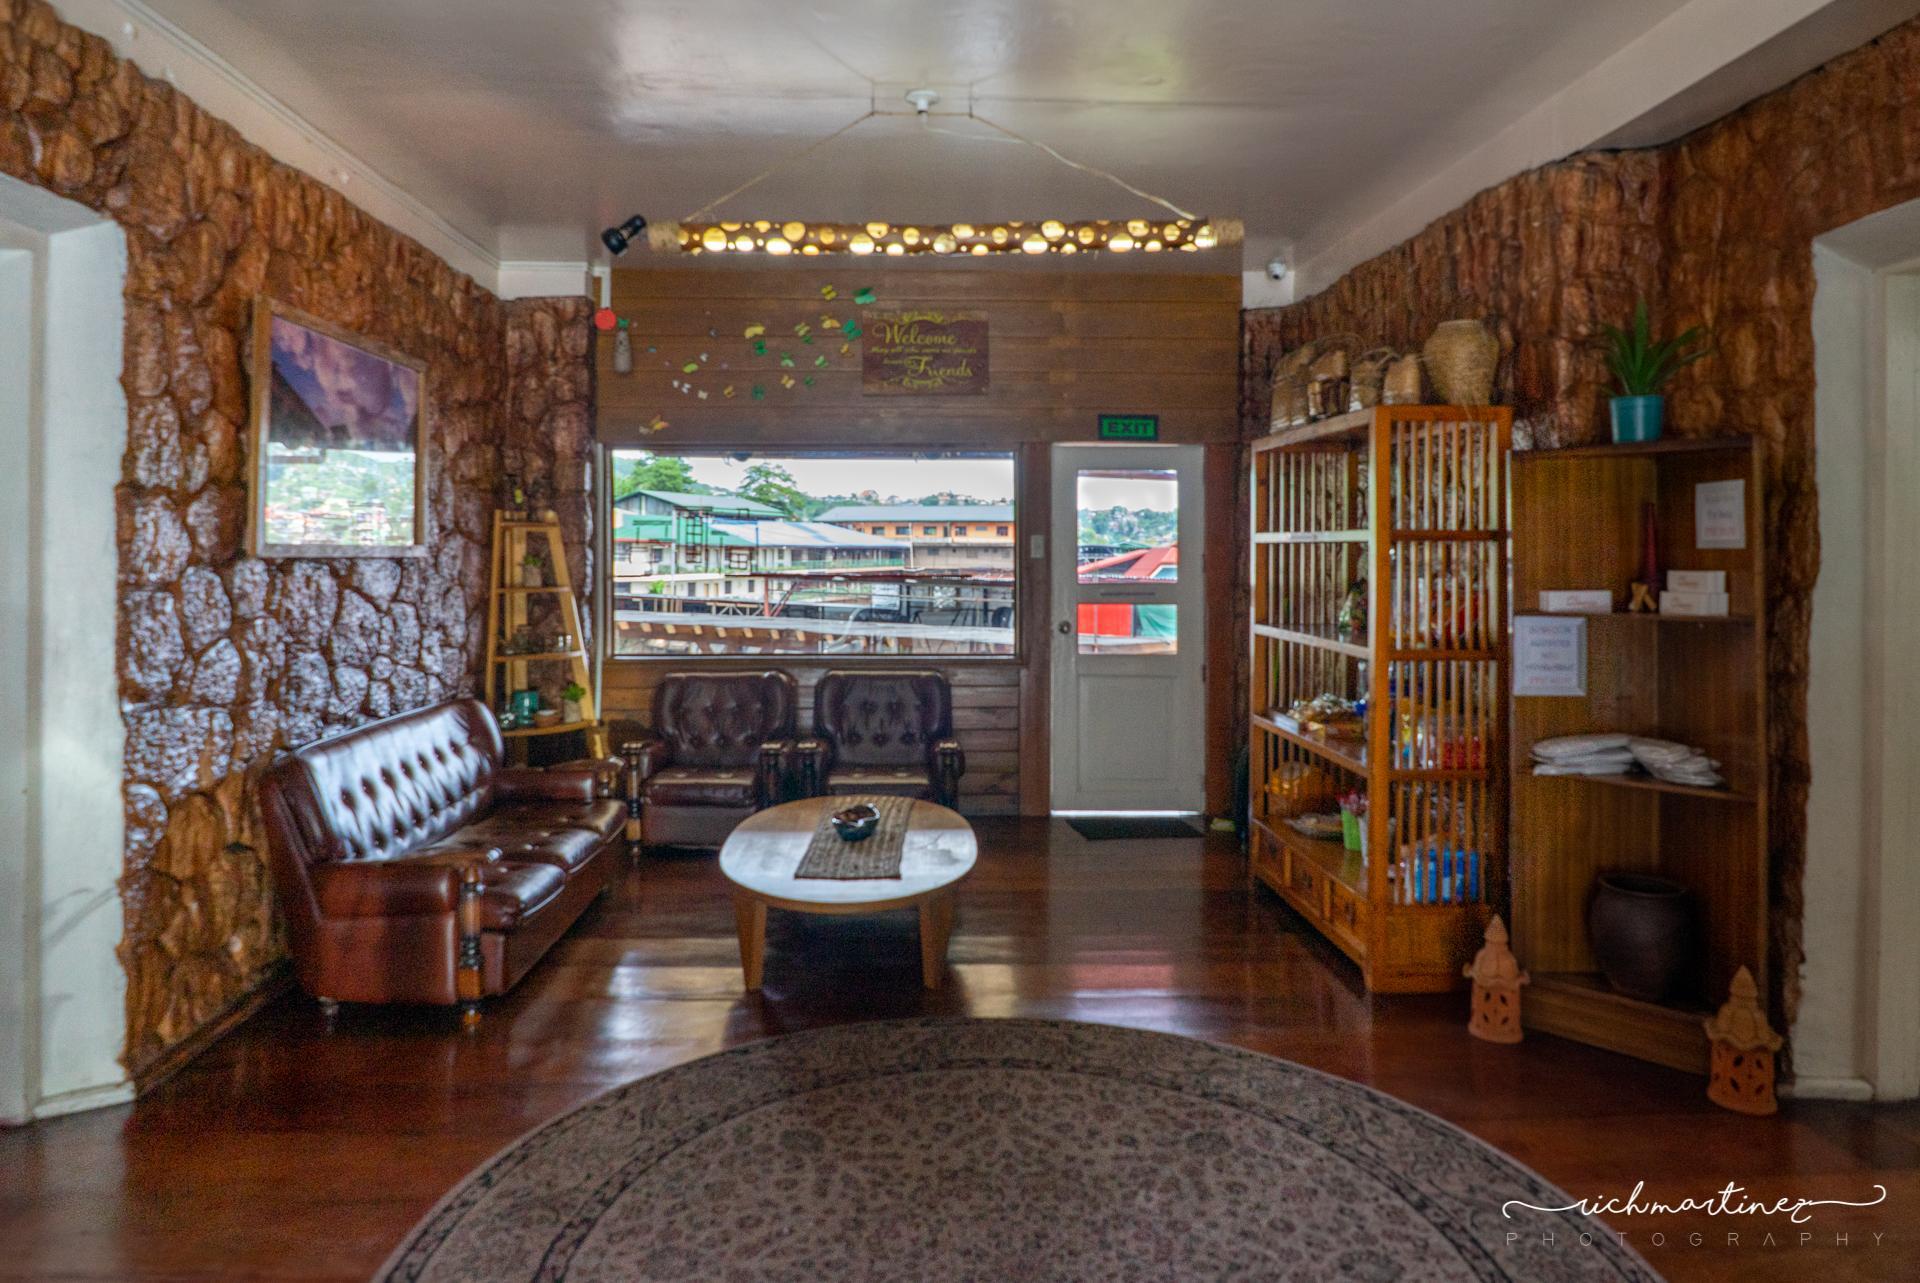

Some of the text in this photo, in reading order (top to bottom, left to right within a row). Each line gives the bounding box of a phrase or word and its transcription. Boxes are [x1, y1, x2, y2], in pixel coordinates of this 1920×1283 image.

[872, 321, 957, 345] Welcome
[904, 356, 973, 377] Friends
[1107, 421, 1151, 434] EXIT
